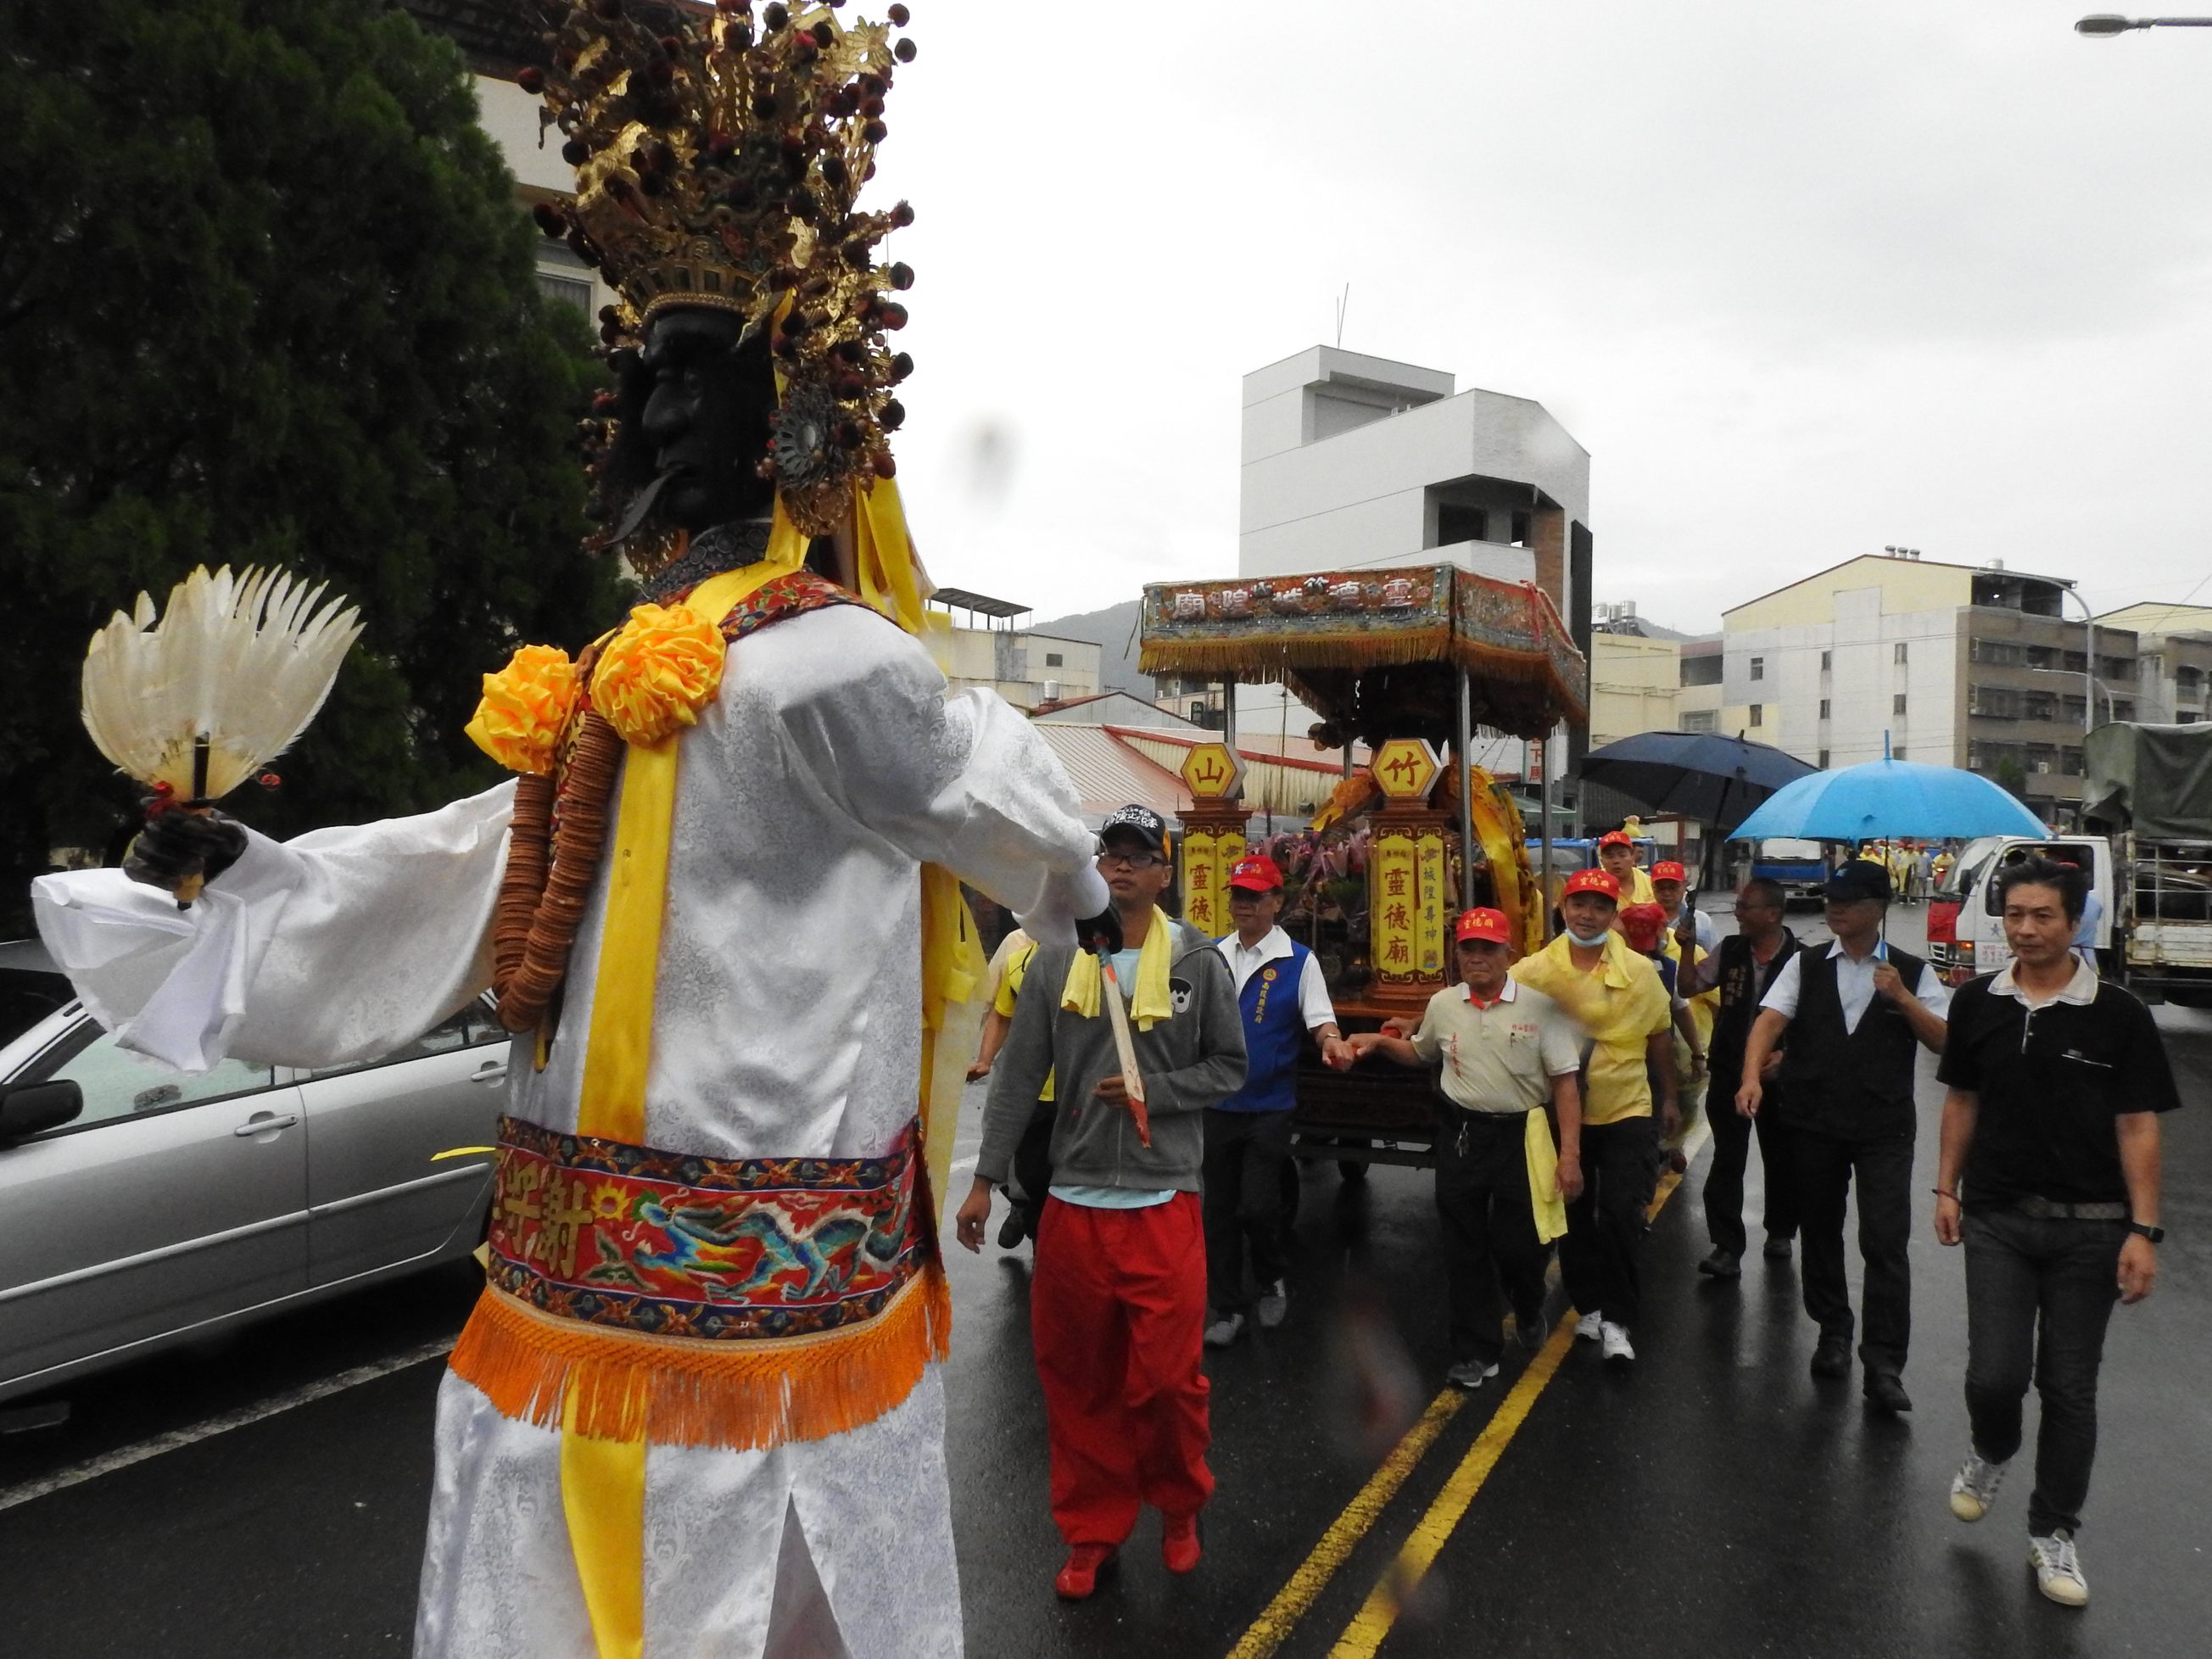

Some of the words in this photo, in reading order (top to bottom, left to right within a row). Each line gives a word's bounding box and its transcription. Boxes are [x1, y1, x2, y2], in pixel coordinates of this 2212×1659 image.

[1194, 757, 1225, 784] 山
[1384, 751, 1421, 787] 竹
[1189, 863, 1213, 936] 靈德
[1383, 868, 1410, 965] 靈德廟
[1423, 867, 1438, 941] 城隍尊神
[492, 1148, 593, 1279] 謝將
